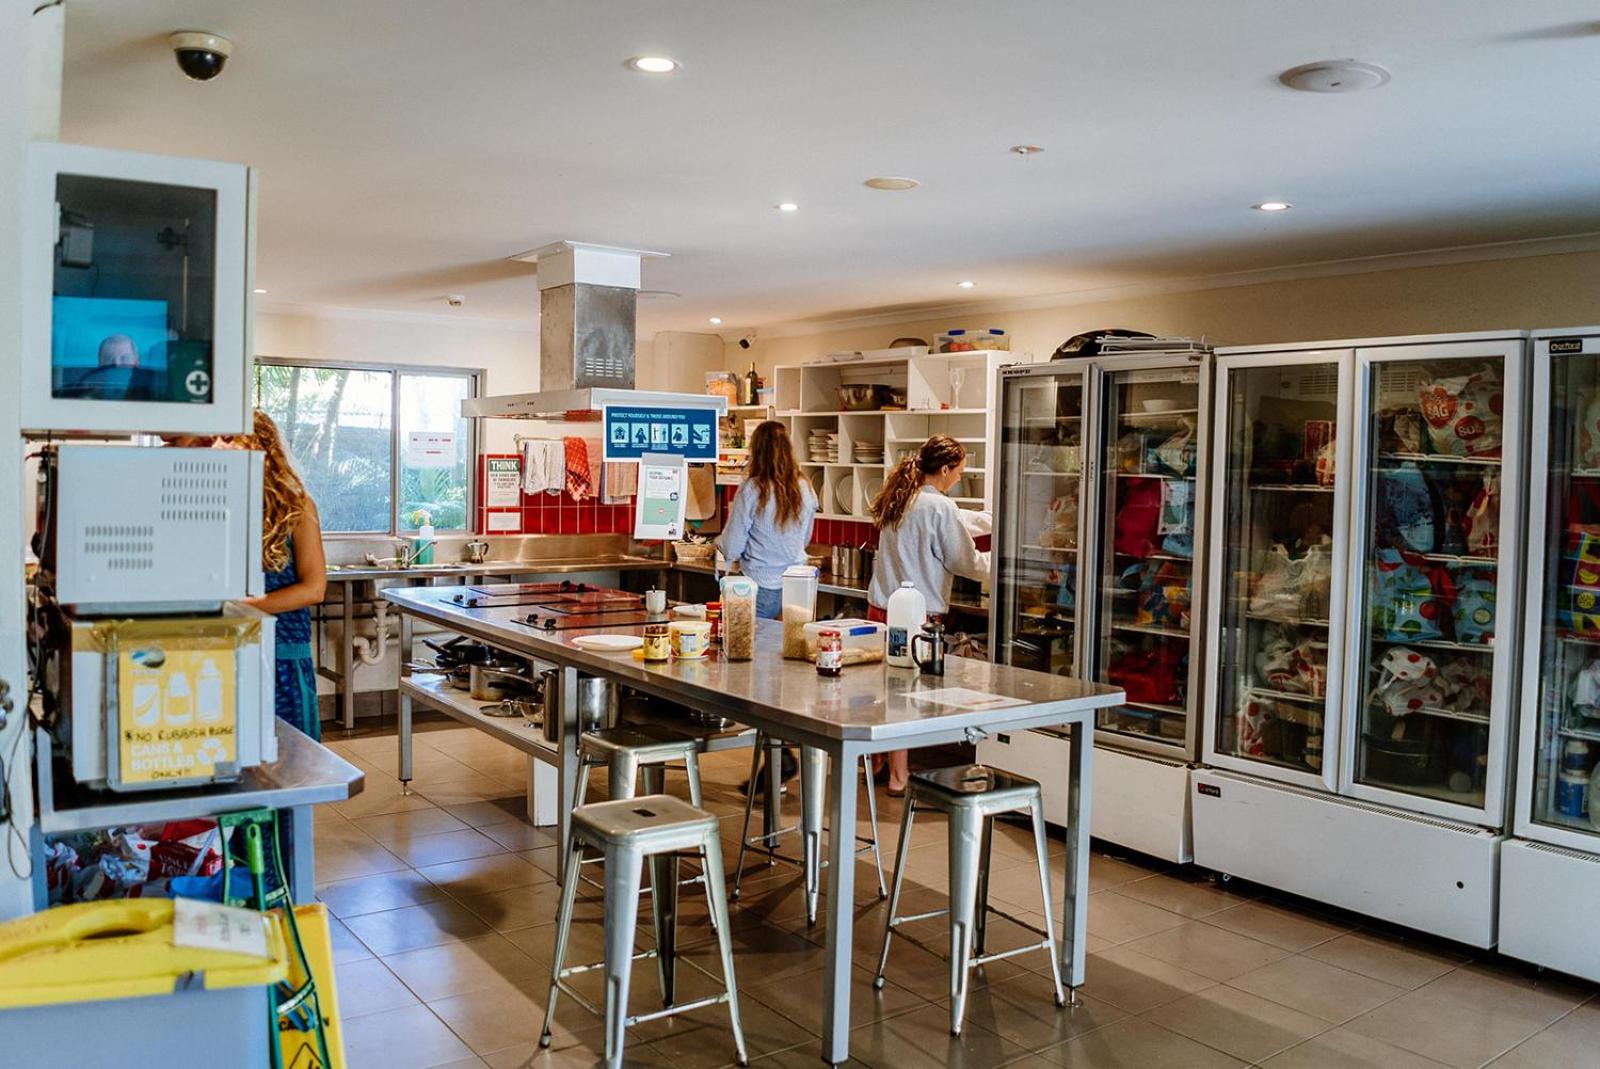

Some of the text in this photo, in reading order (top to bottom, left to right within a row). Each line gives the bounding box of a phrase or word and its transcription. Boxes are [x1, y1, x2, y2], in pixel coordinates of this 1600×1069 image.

[490, 460, 518, 471] THINK
[136, 732, 152, 742] NO
[131, 743, 169, 757] CANS
[131, 754, 195, 771] BOTTLES
